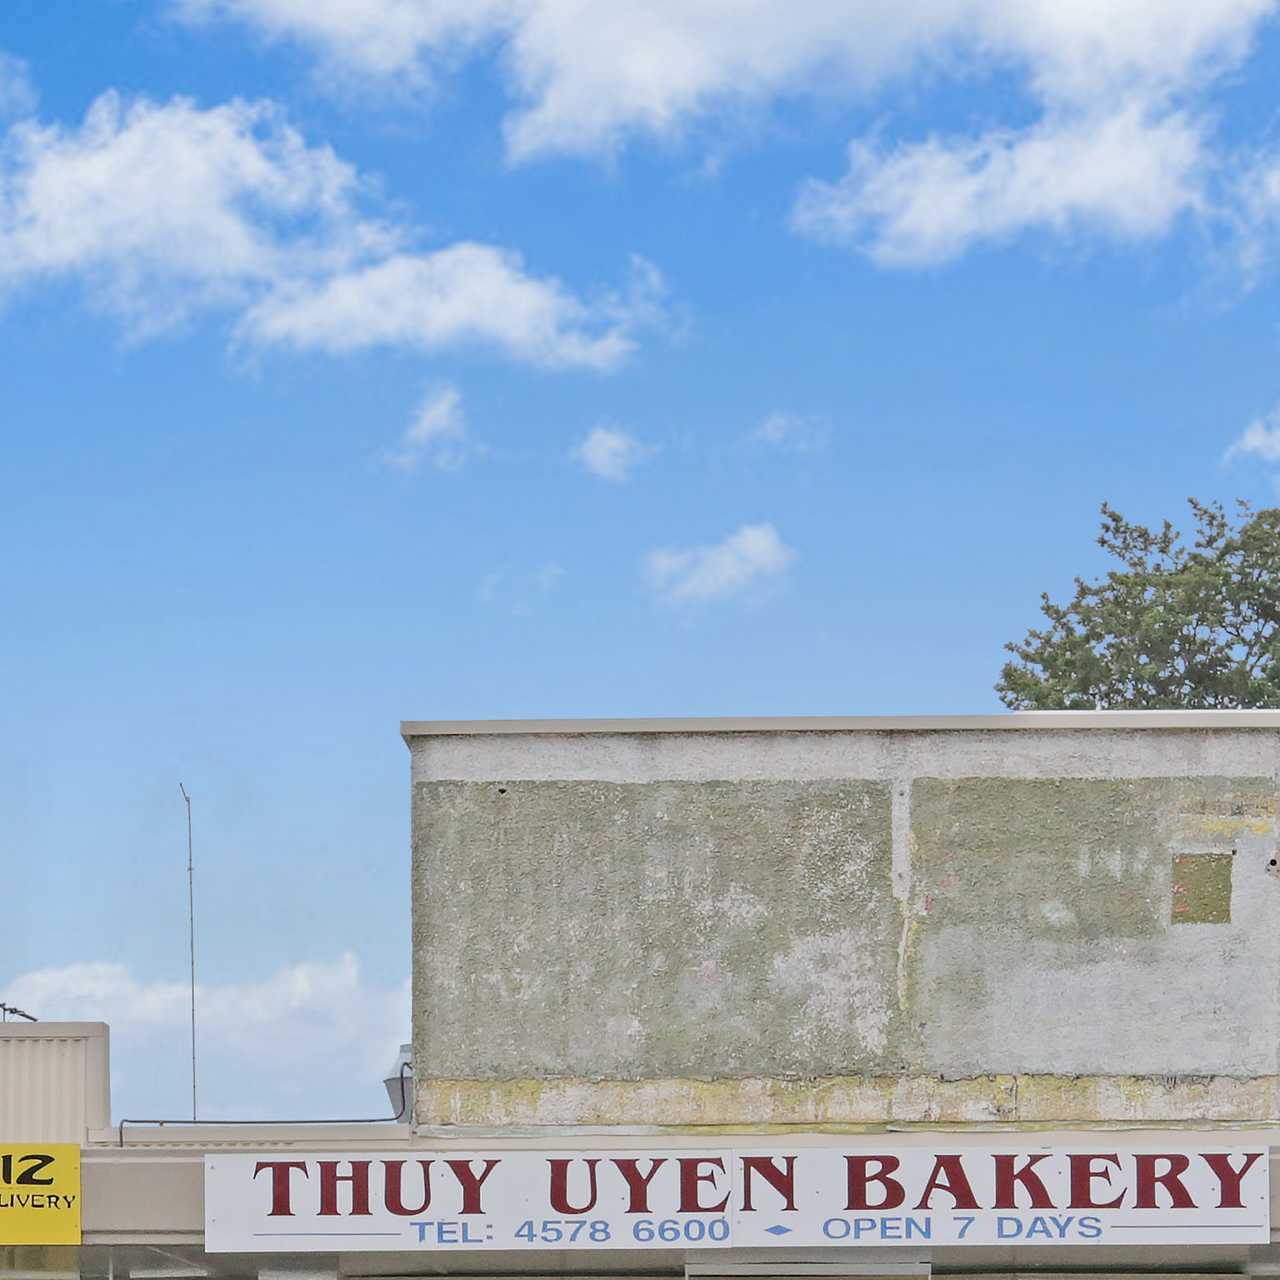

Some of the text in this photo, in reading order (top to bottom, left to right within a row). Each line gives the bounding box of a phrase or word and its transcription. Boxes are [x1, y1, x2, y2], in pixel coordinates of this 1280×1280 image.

[253, 1153, 1265, 1216] THUY UYEN BAKERY
[410, 1219, 730, 1244] TEL: 4578 6600
[822, 1215, 1103, 1241] OPEN 7 DAYS
